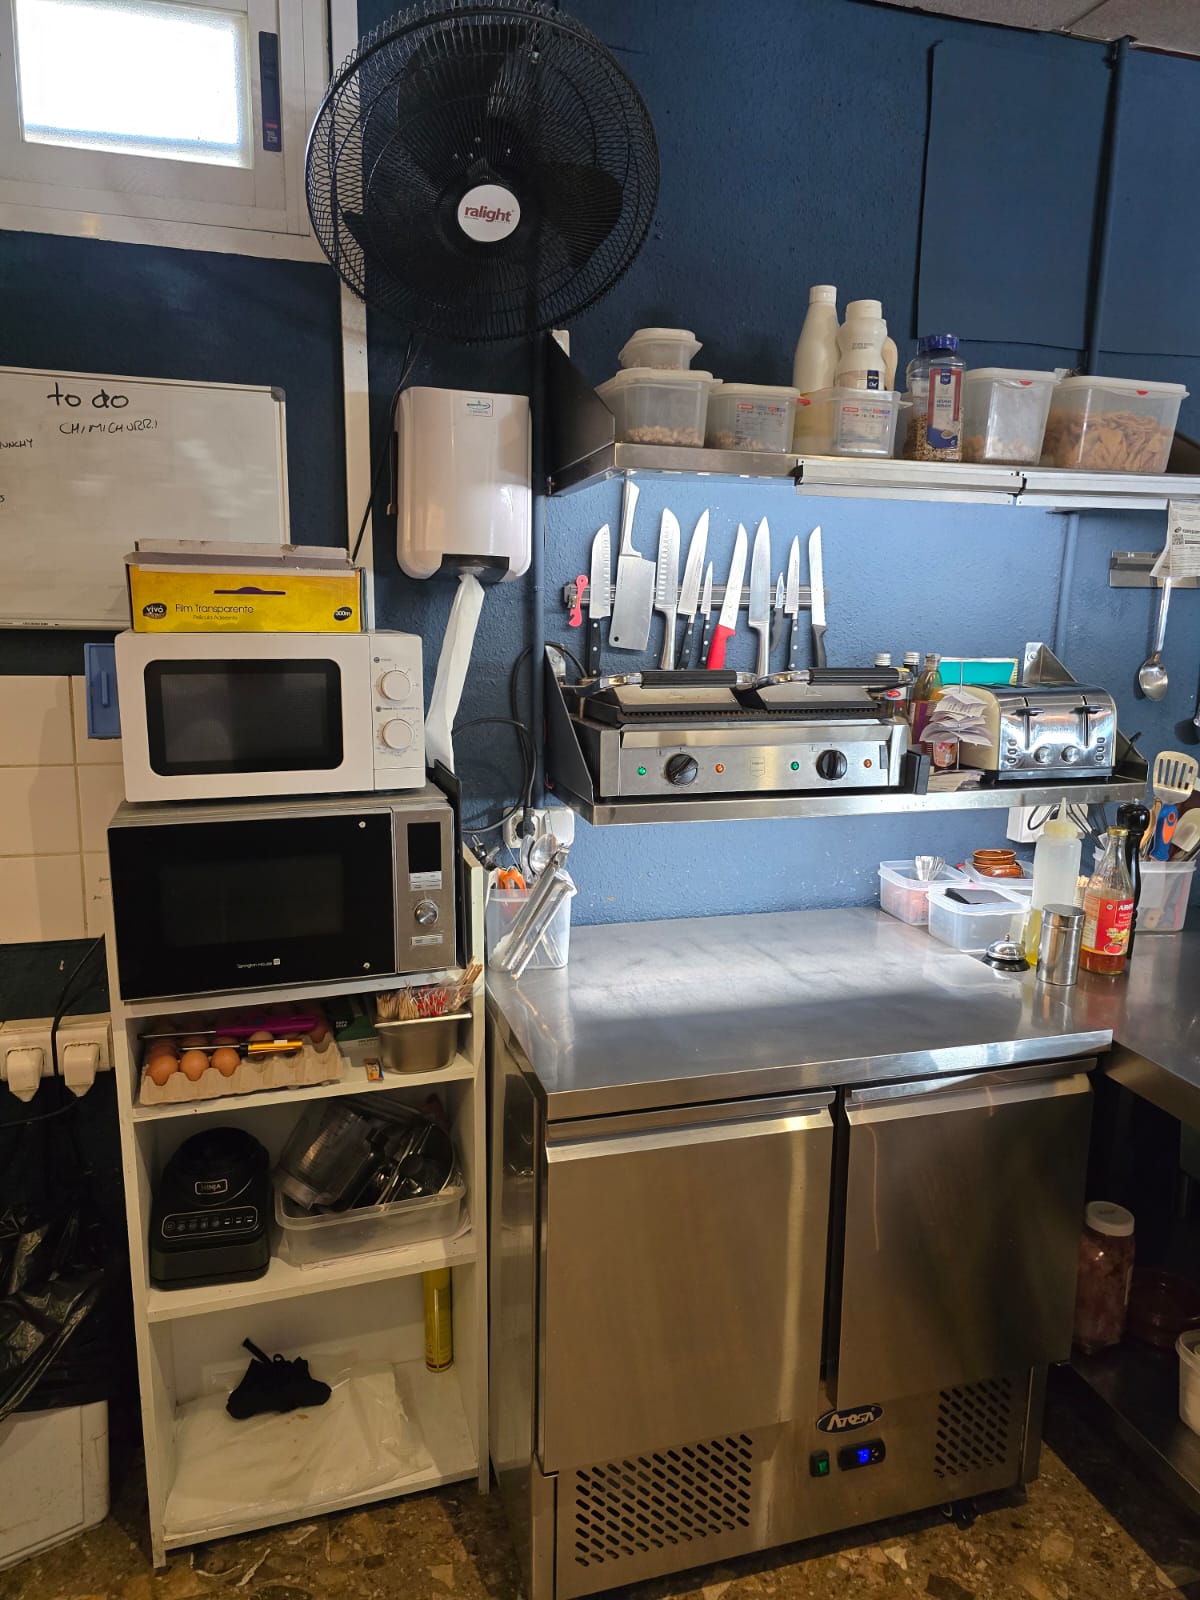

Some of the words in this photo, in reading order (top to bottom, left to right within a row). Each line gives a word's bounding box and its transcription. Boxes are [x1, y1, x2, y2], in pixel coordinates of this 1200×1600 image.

[464, 205, 512, 223] ralight
[47, 382, 82, 407] to
[92, 388, 129, 409] do
[0, 438, 33, 449] UNCHY
[175, 603, 193, 613] Film
[195, 603, 254, 615] Transparente
